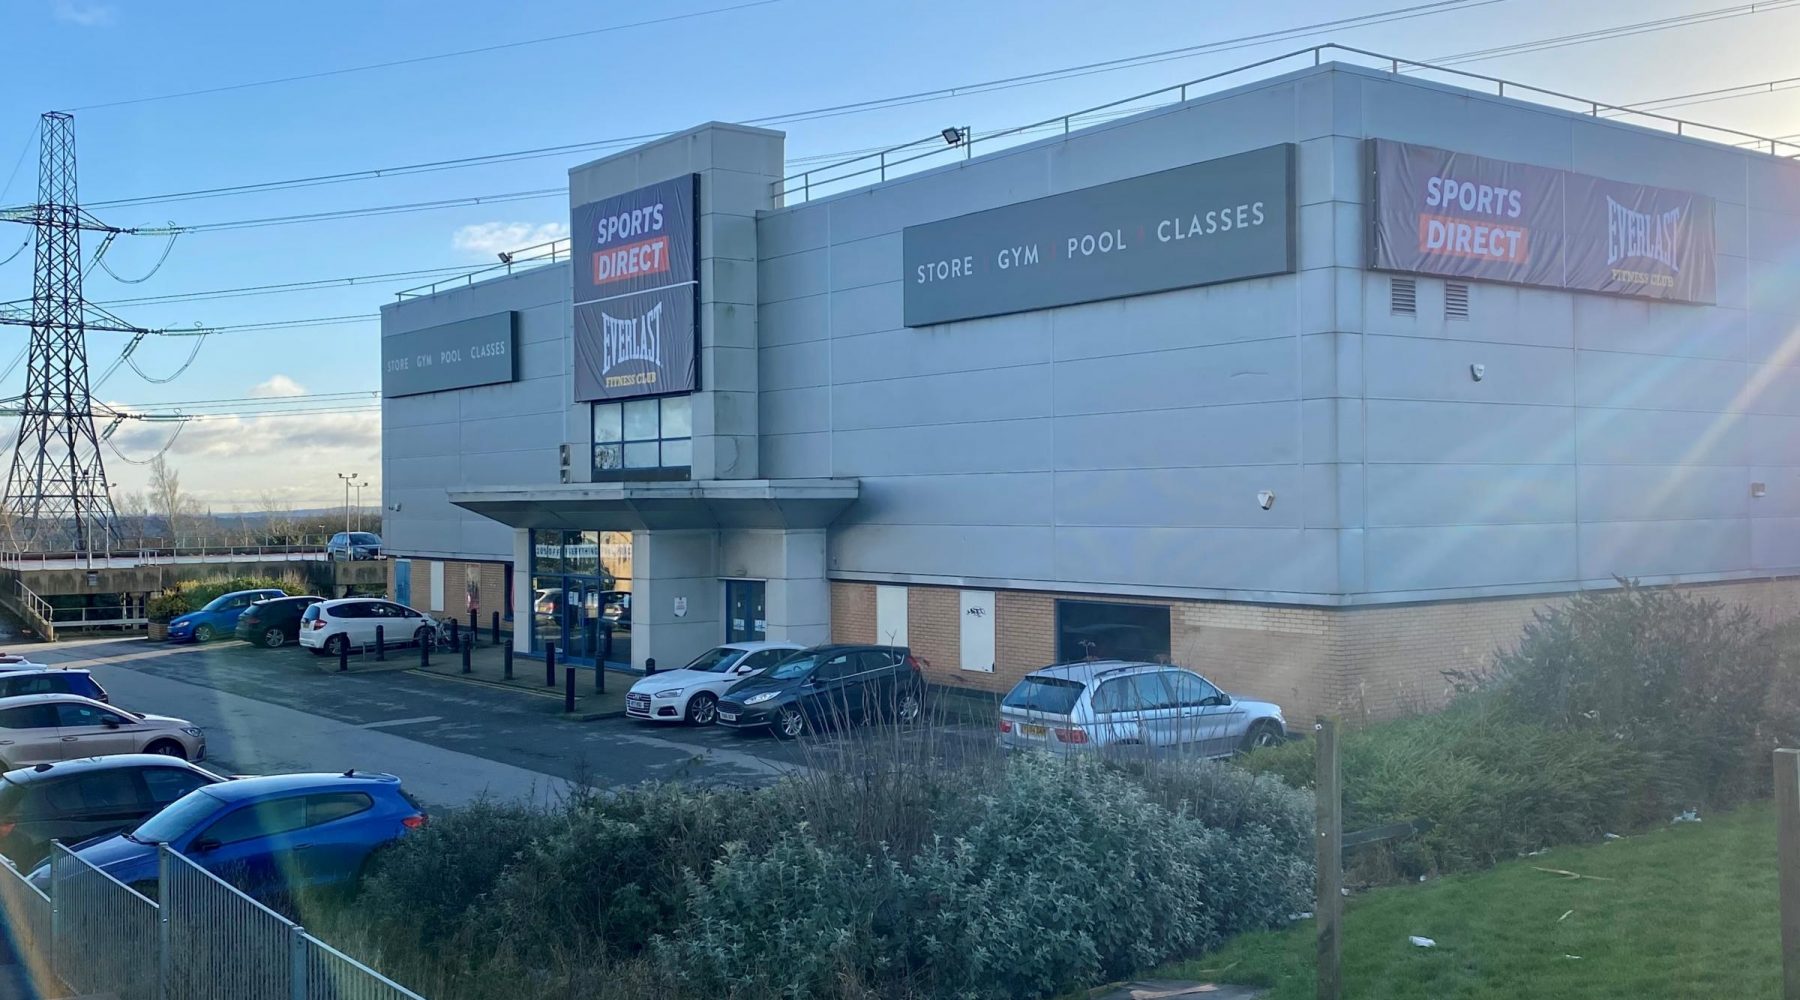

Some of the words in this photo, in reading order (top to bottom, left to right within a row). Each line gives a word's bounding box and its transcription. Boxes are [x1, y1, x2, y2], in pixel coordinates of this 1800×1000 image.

[1426, 176, 1522, 218] SPORTS
[597, 203, 664, 244] SPORTS
[917, 256, 973, 284] STORE
[997, 244, 1039, 269] GYM
[1068, 228, 1127, 259] POOL
[1157, 201, 1264, 242] CLASSES
[1427, 220, 1521, 258] DIRECT
[1606, 194, 1680, 273] EVERLAST
[598, 241, 664, 281] DIRECT
[1611, 268, 1649, 284] FITNESS
[1650, 273, 1674, 287] CLUB
[387, 358, 409, 373] STORE
[416, 354, 432, 367] GYM
[440, 350, 461, 364] POOL
[470, 341, 505, 359] CLASSES
[602, 301, 662, 375] EVERLAST
[605, 374, 636, 388] FITNESS
[636, 371, 657, 385] CLUB
